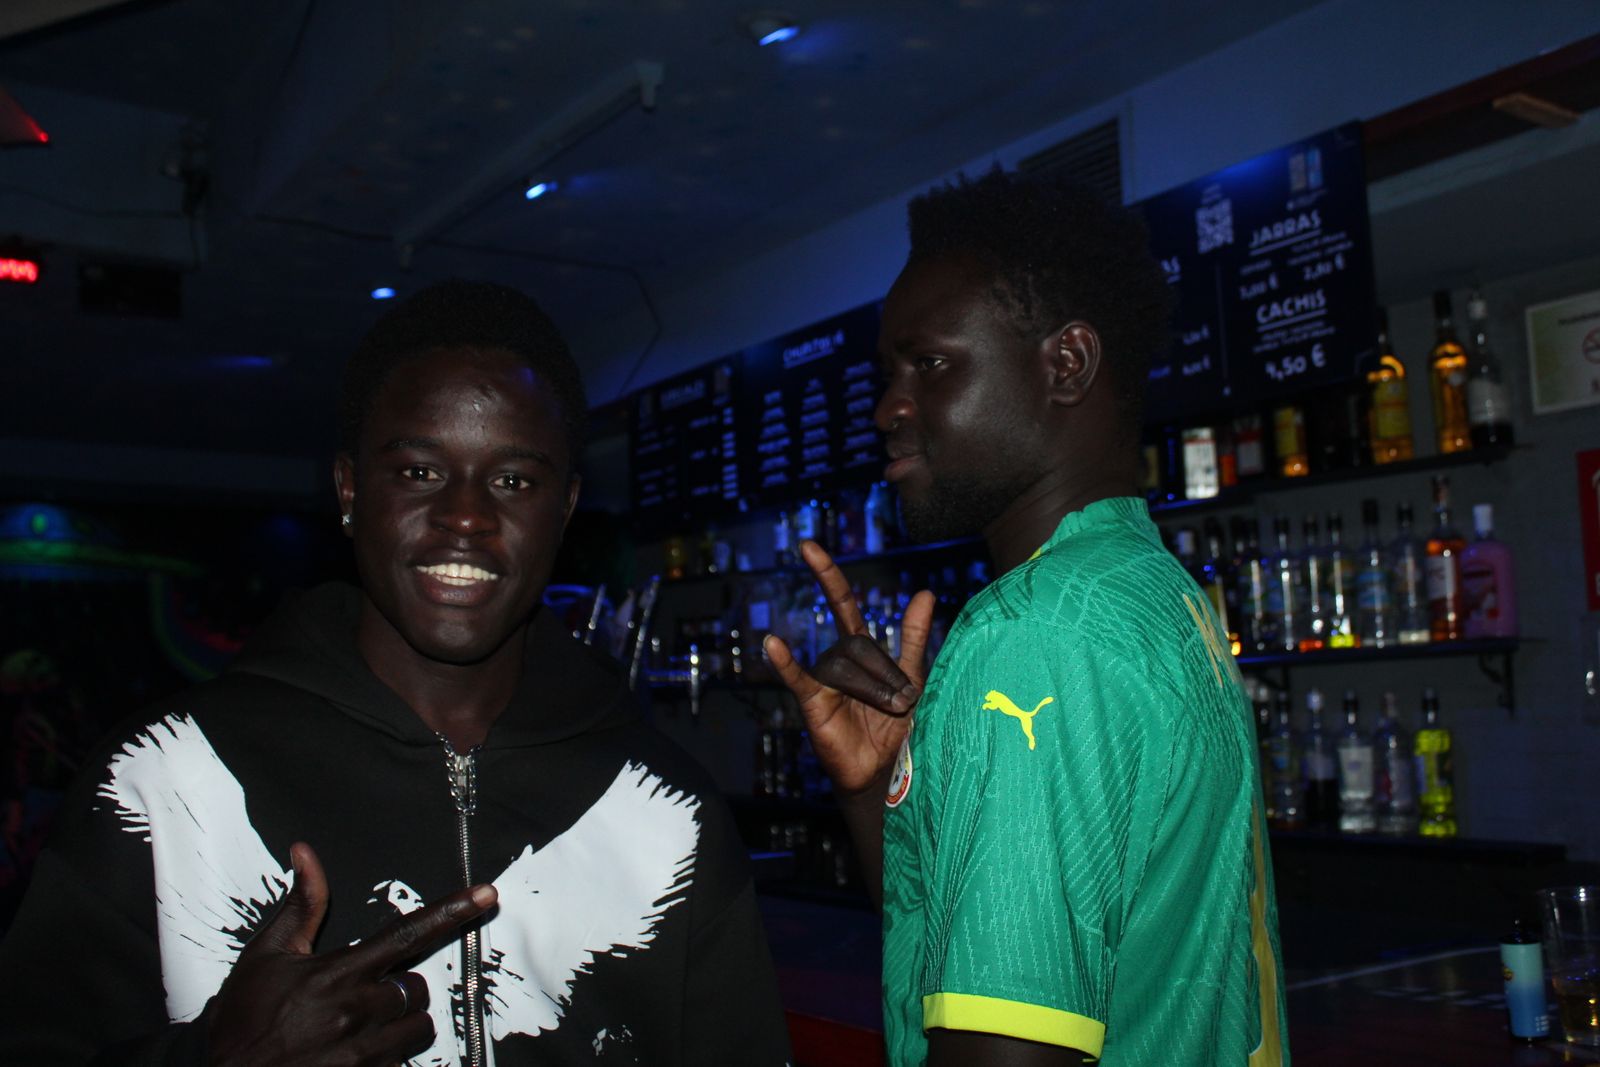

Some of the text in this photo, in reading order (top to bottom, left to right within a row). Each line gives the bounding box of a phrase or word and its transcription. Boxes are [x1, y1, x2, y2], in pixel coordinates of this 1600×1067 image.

[1248, 208, 1322, 248] JARRAS
[1255, 287, 1327, 324] CACHIS
[1264, 341, 1328, 382] 4,50 €
